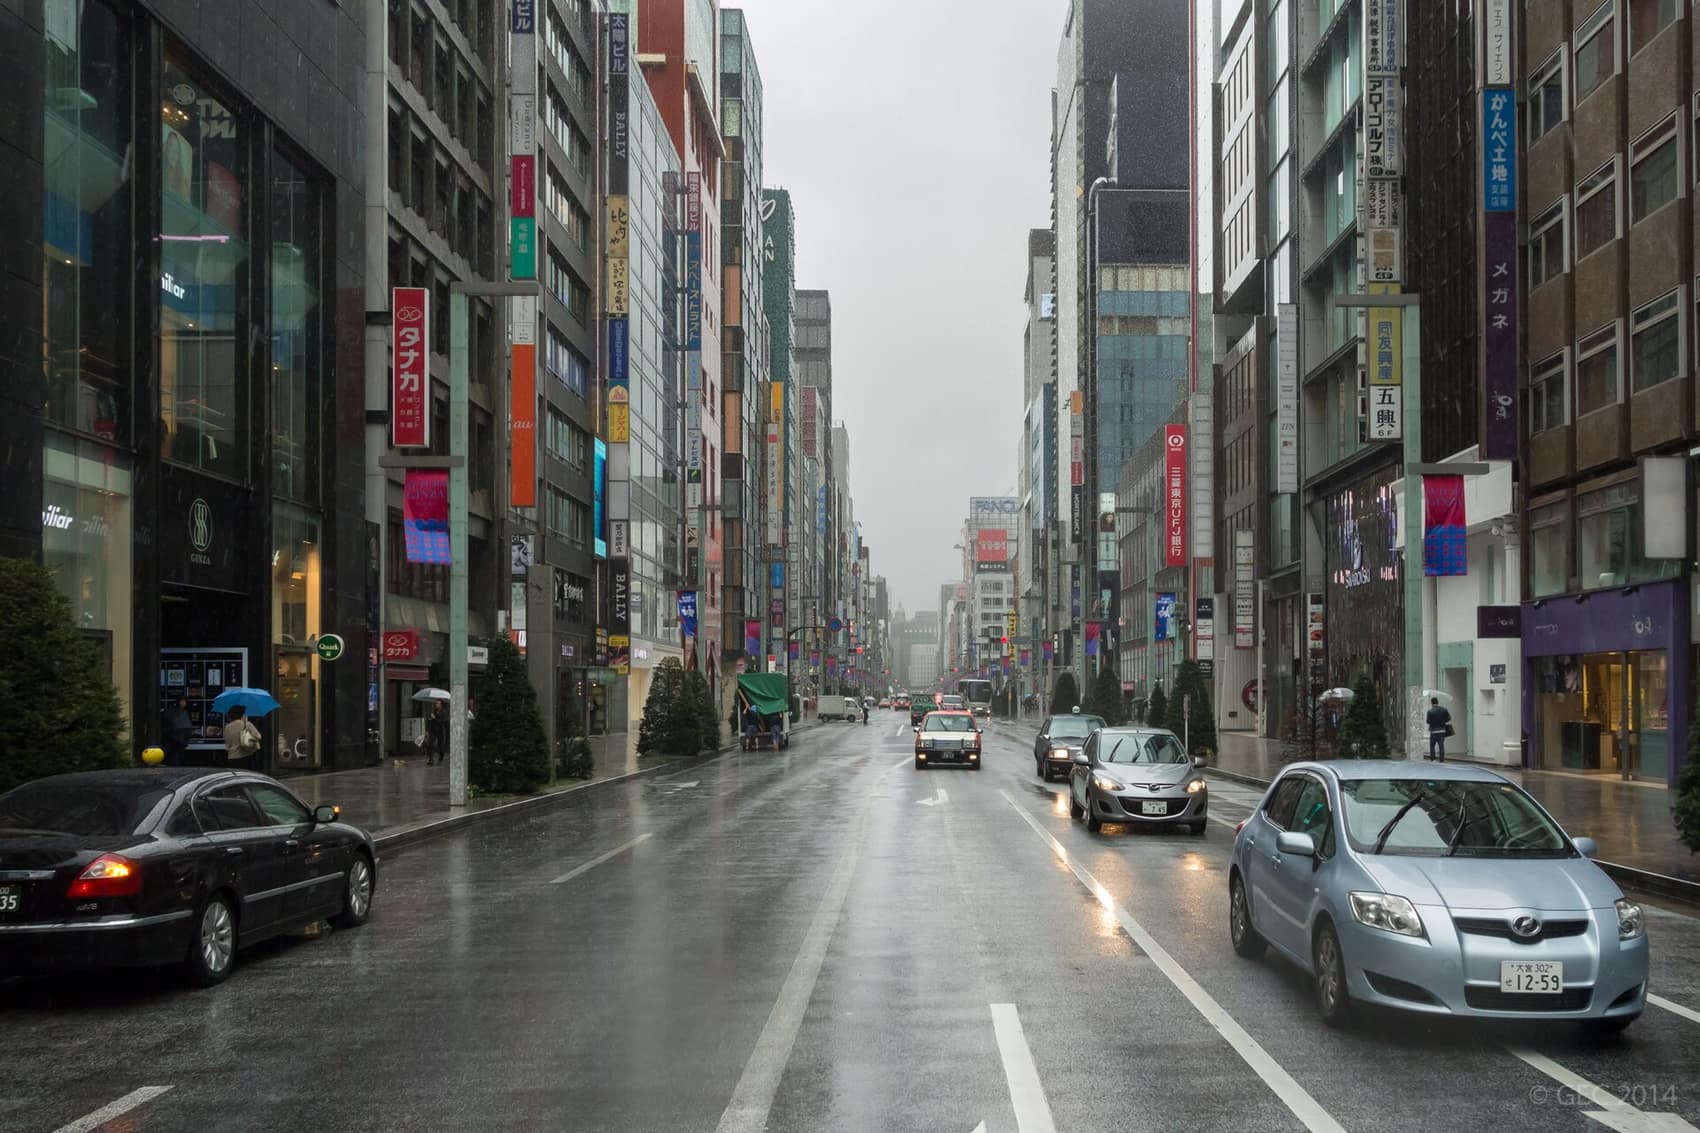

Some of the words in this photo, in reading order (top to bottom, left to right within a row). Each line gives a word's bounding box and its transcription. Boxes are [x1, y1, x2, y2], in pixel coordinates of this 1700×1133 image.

[515, 0, 531, 30] ビル
[616, 111, 626, 158] BALLY
[1491, 94, 1507, 181] かんべ土地
[1493, 262, 1508, 328] メガネ
[400, 327, 420, 391] タナカ
[1376, 388, 1396, 428] 五興
[1171, 467, 1181, 557] 三菱東京UFJ銀行
[616, 574, 626, 621] BALLY
[387, 647, 410, 657] タナカ
[0, 895, 17, 910] 35
[1515, 963, 1533, 973] 大宮
[1518, 975, 1560, 990] 12-59
